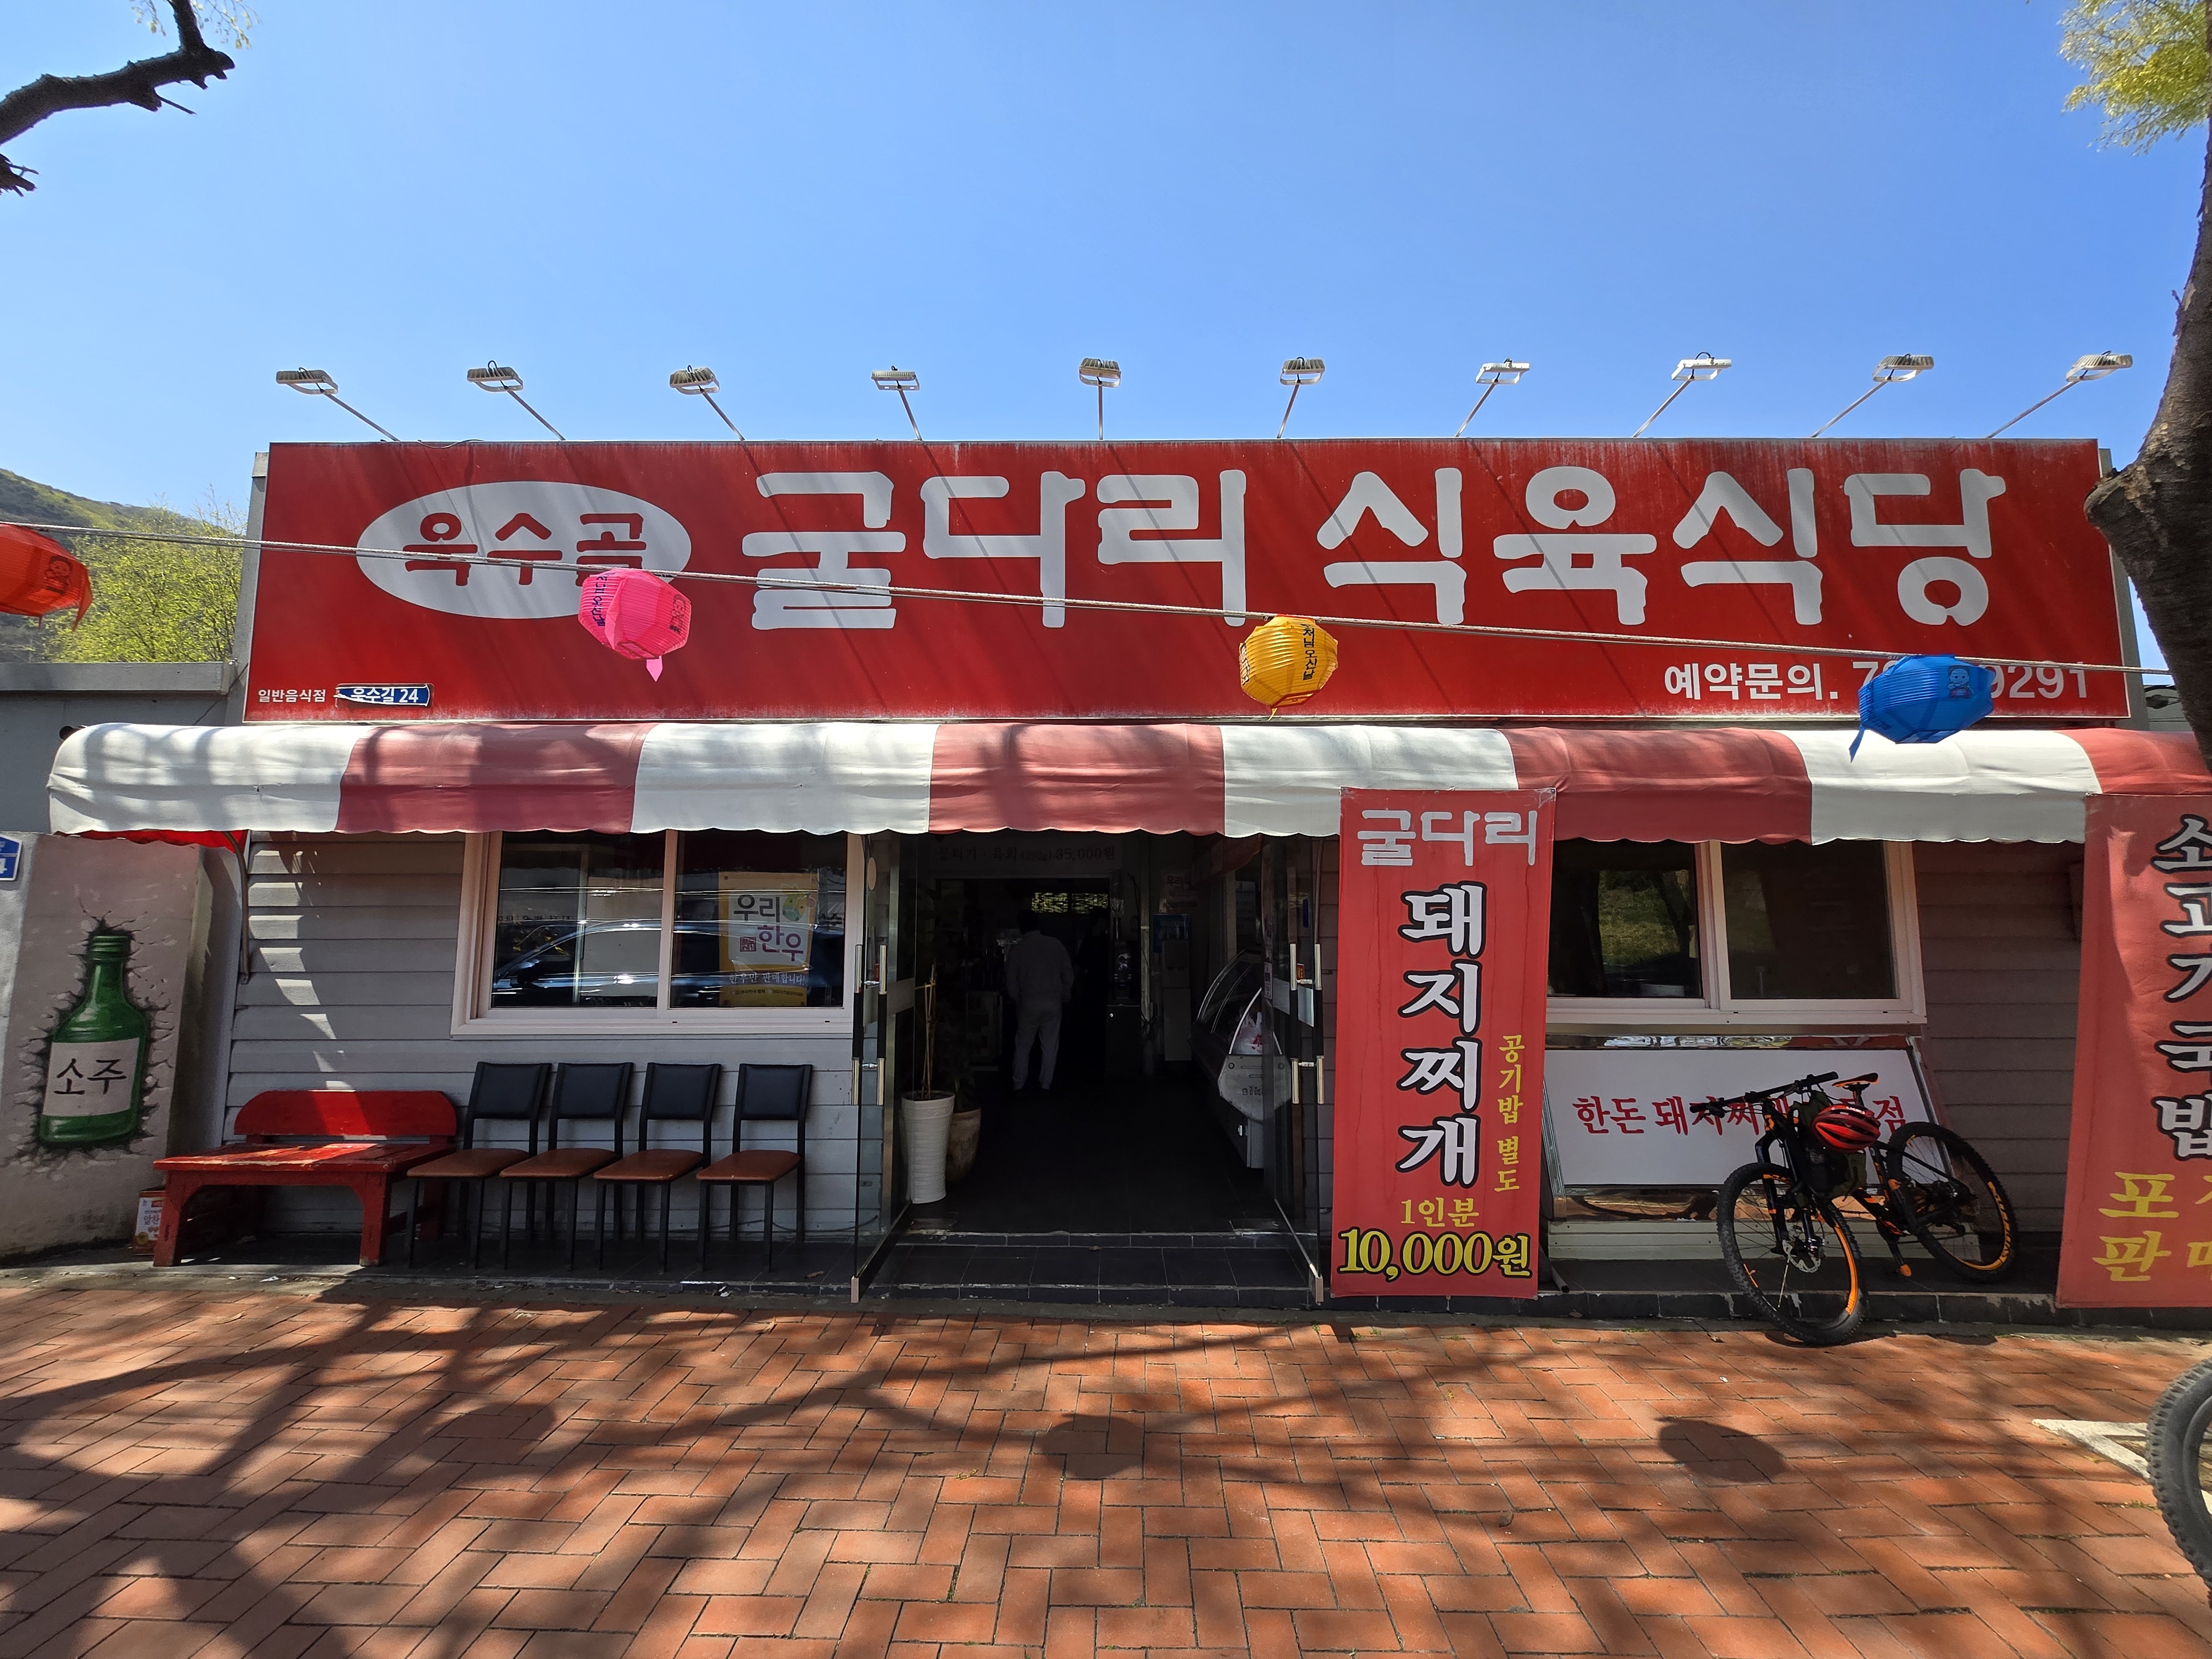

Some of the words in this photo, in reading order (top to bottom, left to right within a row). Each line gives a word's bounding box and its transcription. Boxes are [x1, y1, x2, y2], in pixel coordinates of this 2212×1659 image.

[742, 469, 1246, 629] 굴다리
[1317, 466, 2006, 626] 식육식당
[258, 689, 326, 702] 일반음식점
[399, 688, 419, 703] 24
[992, 846, 1017, 862] 육회
[1055, 845, 1115, 862] 35,000원
[1358, 808, 1538, 867] 굴다리
[734, 894, 780, 922] 우리
[758, 925, 804, 961] 한우
[729, 972, 759, 984] 한우만
[763, 972, 805, 985] 판매합니다!
[1396, 881, 1488, 1187] 돼지찌개
[54, 1058, 127, 1094] 소주
[1498, 1034, 1526, 1124] 공기밥
[1572, 1096, 1646, 1134] 한돈
[1494, 1136, 1520, 1193] 별도
[1400, 1197, 1479, 1228] 1인분
[1338, 1227, 1532, 1281] 10,000원
